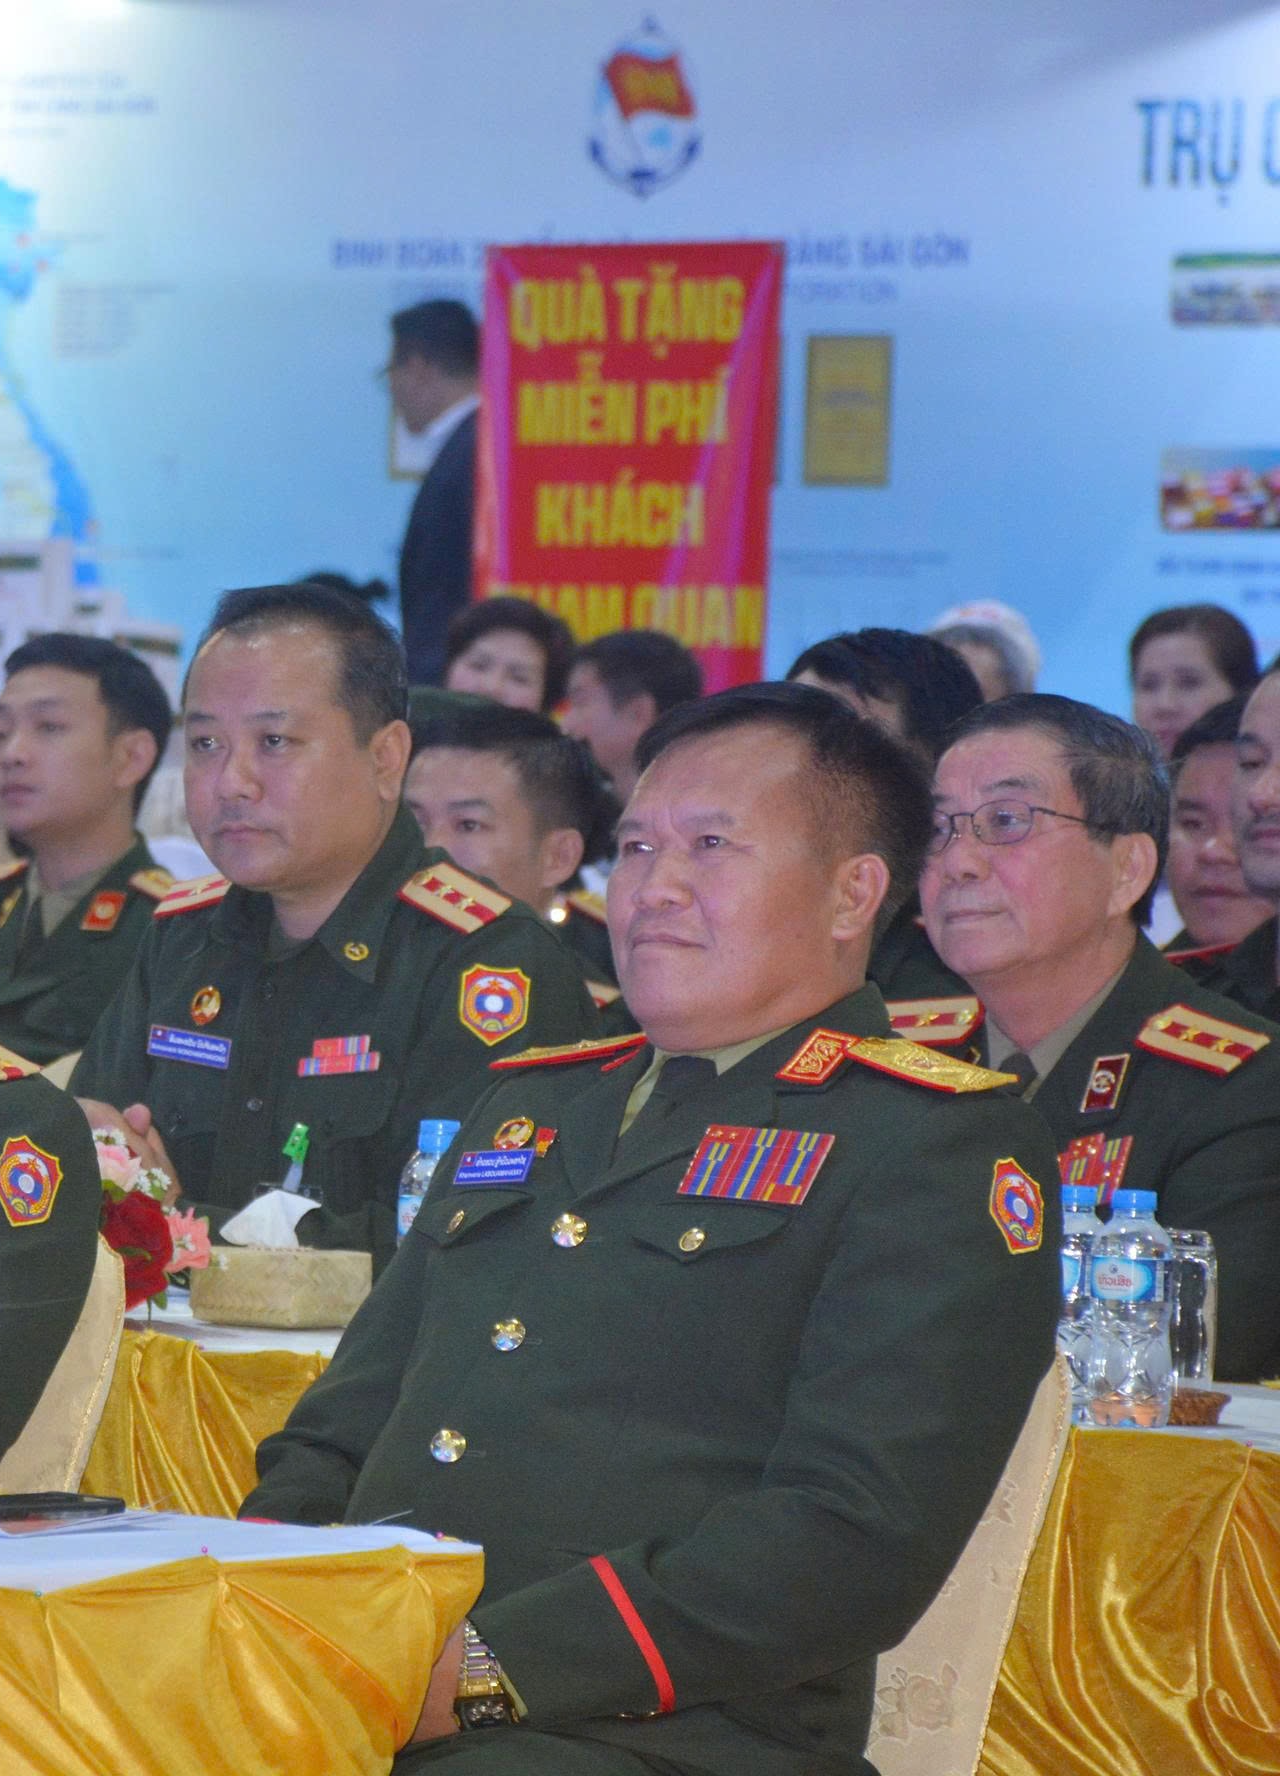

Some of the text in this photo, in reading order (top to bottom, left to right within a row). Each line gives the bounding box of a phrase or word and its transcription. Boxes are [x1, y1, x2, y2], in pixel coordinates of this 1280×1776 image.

[1137, 97, 1242, 206] TRỤ
[511, 260, 745, 359] QUÀ TẶNG
[518, 350, 636, 445] MIỄN
[645, 363, 731, 445] PHÍ
[535, 465, 705, 548] KHÁCH
[632, 582, 765, 648] QUAN
